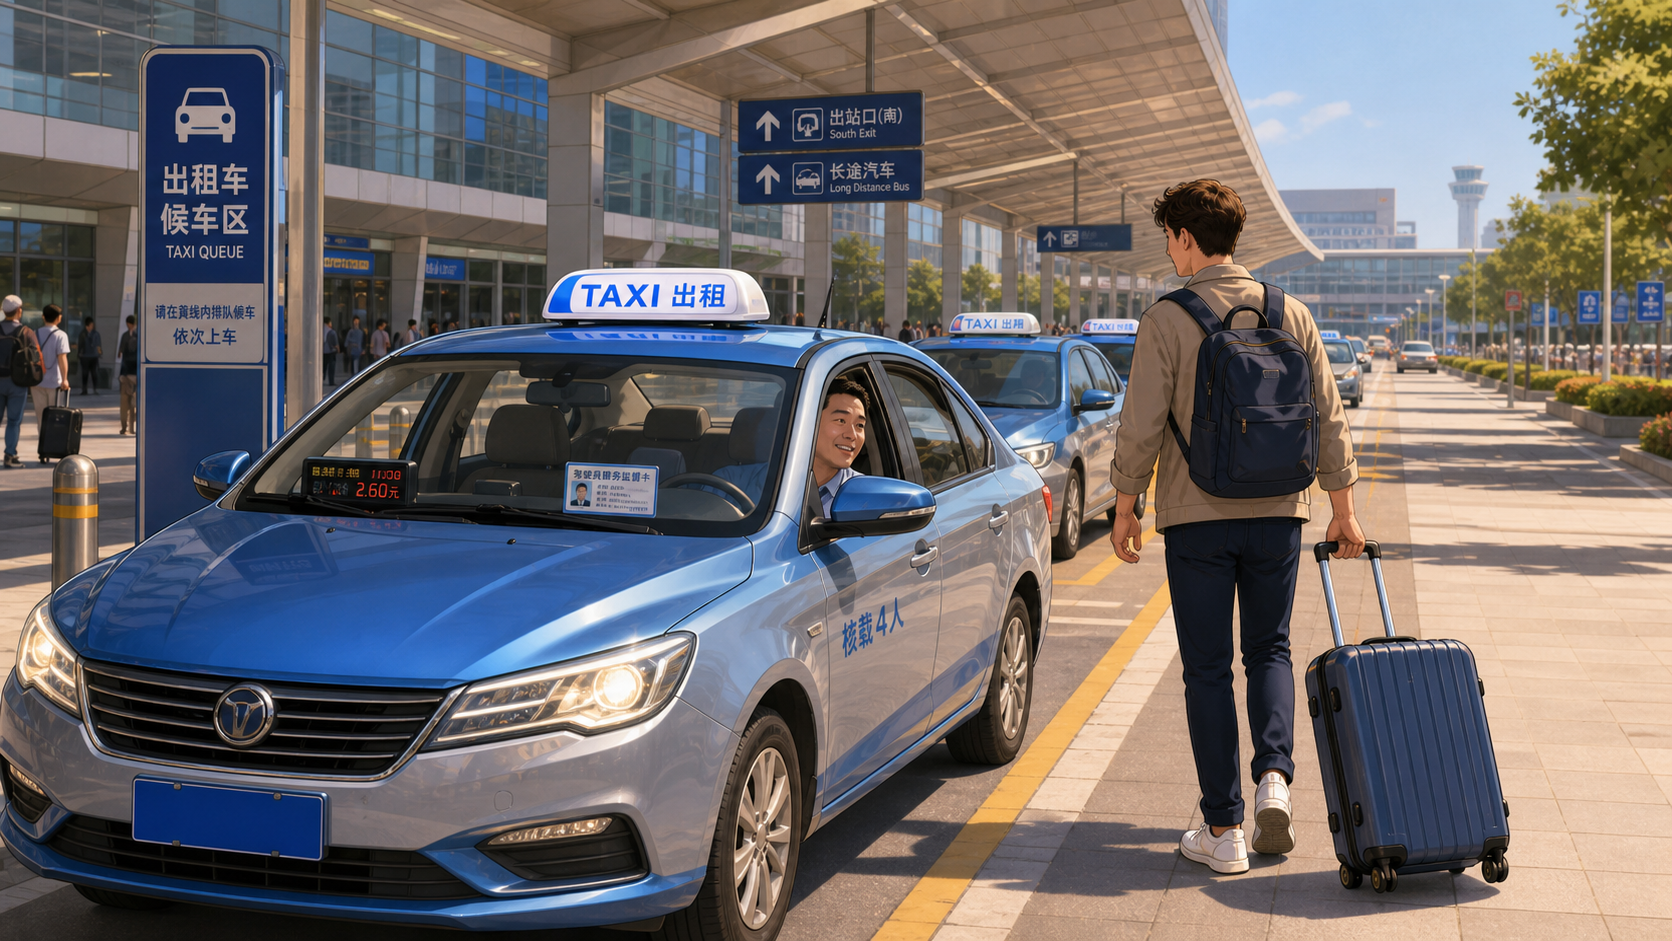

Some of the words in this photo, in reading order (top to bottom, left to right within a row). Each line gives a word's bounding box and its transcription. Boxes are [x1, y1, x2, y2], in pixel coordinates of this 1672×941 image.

[829, 106, 903, 126] 出站口(南)
[829, 129, 857, 140] South
[859, 127, 877, 138] Exit
[163, 163, 249, 195] 出租车
[829, 160, 896, 181] 长途汽车
[829, 183, 852, 195] Long
[853, 182, 891, 193] Distance
[893, 181, 910, 192] Bus
[160, 203, 249, 236] 候车区
[165, 245, 195, 259] TAXI
[199, 245, 244, 260] QUEUE
[580, 283, 660, 308] TAXI
[671, 282, 726, 308] 出租
[964, 318, 998, 330] TAXI
[1092, 322, 1115, 331] TAXI
[173, 327, 237, 346] 依次上车
[355, 481, 400, 499] 2.60元
